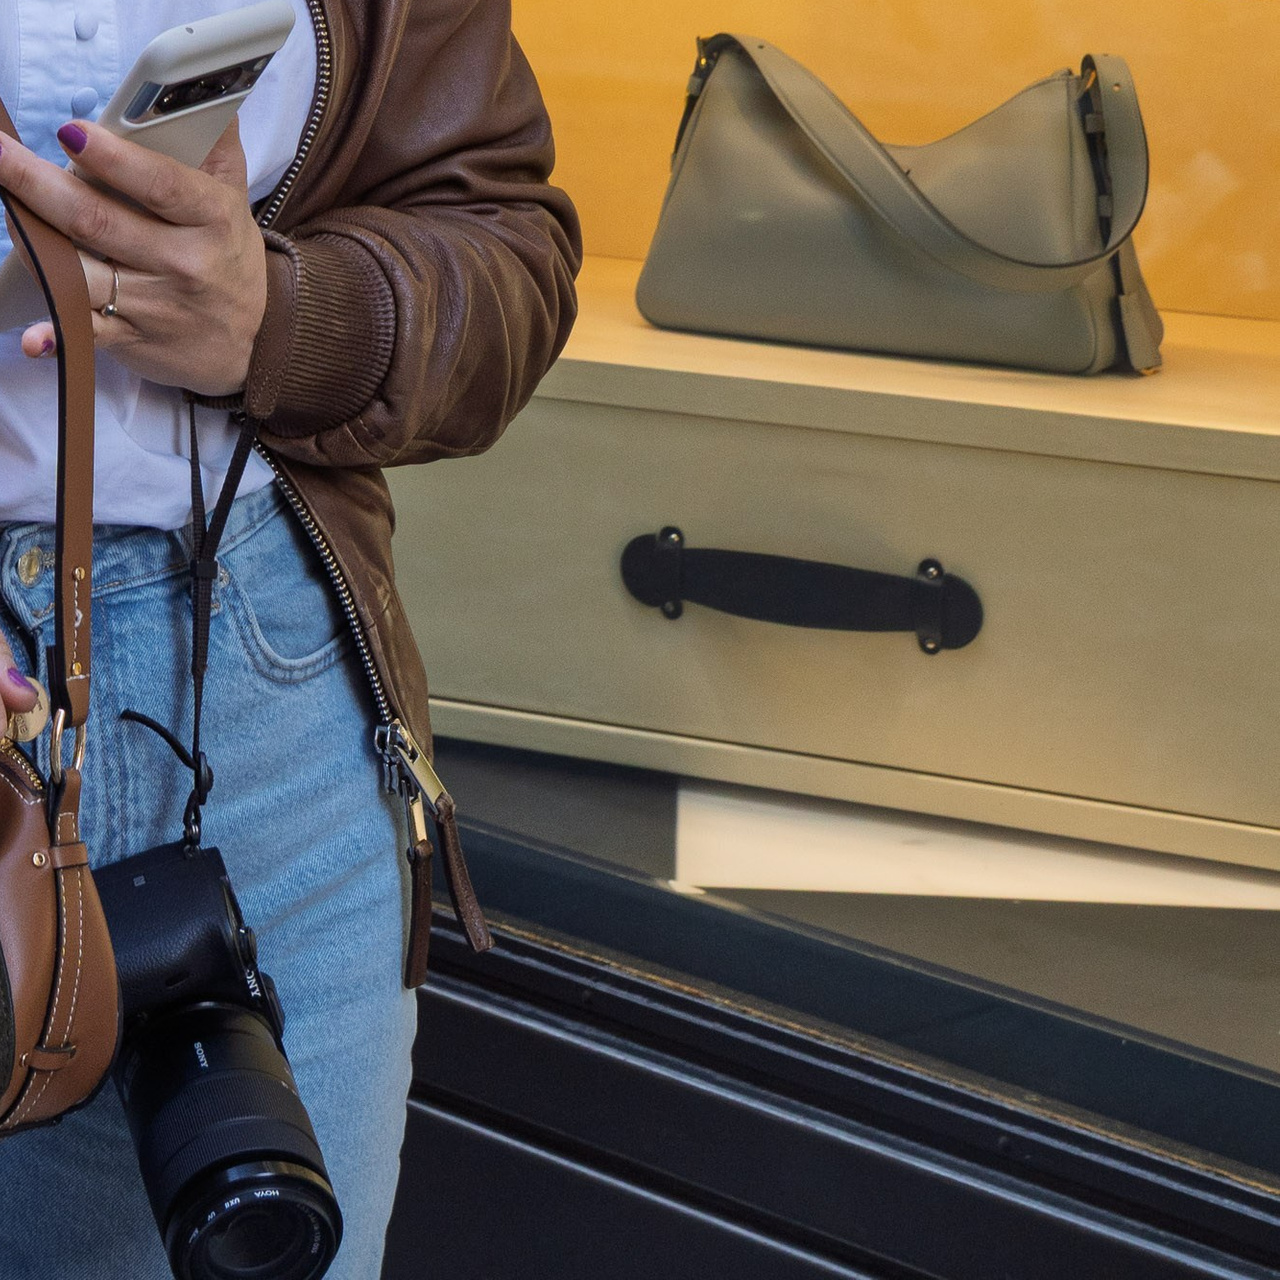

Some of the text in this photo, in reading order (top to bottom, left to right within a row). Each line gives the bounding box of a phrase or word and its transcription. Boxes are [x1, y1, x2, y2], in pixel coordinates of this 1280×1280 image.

[244, 968, 261, 998] ONY
[193, 1041, 209, 1069] SONY
[254, 1189, 280, 1198] HOYA
